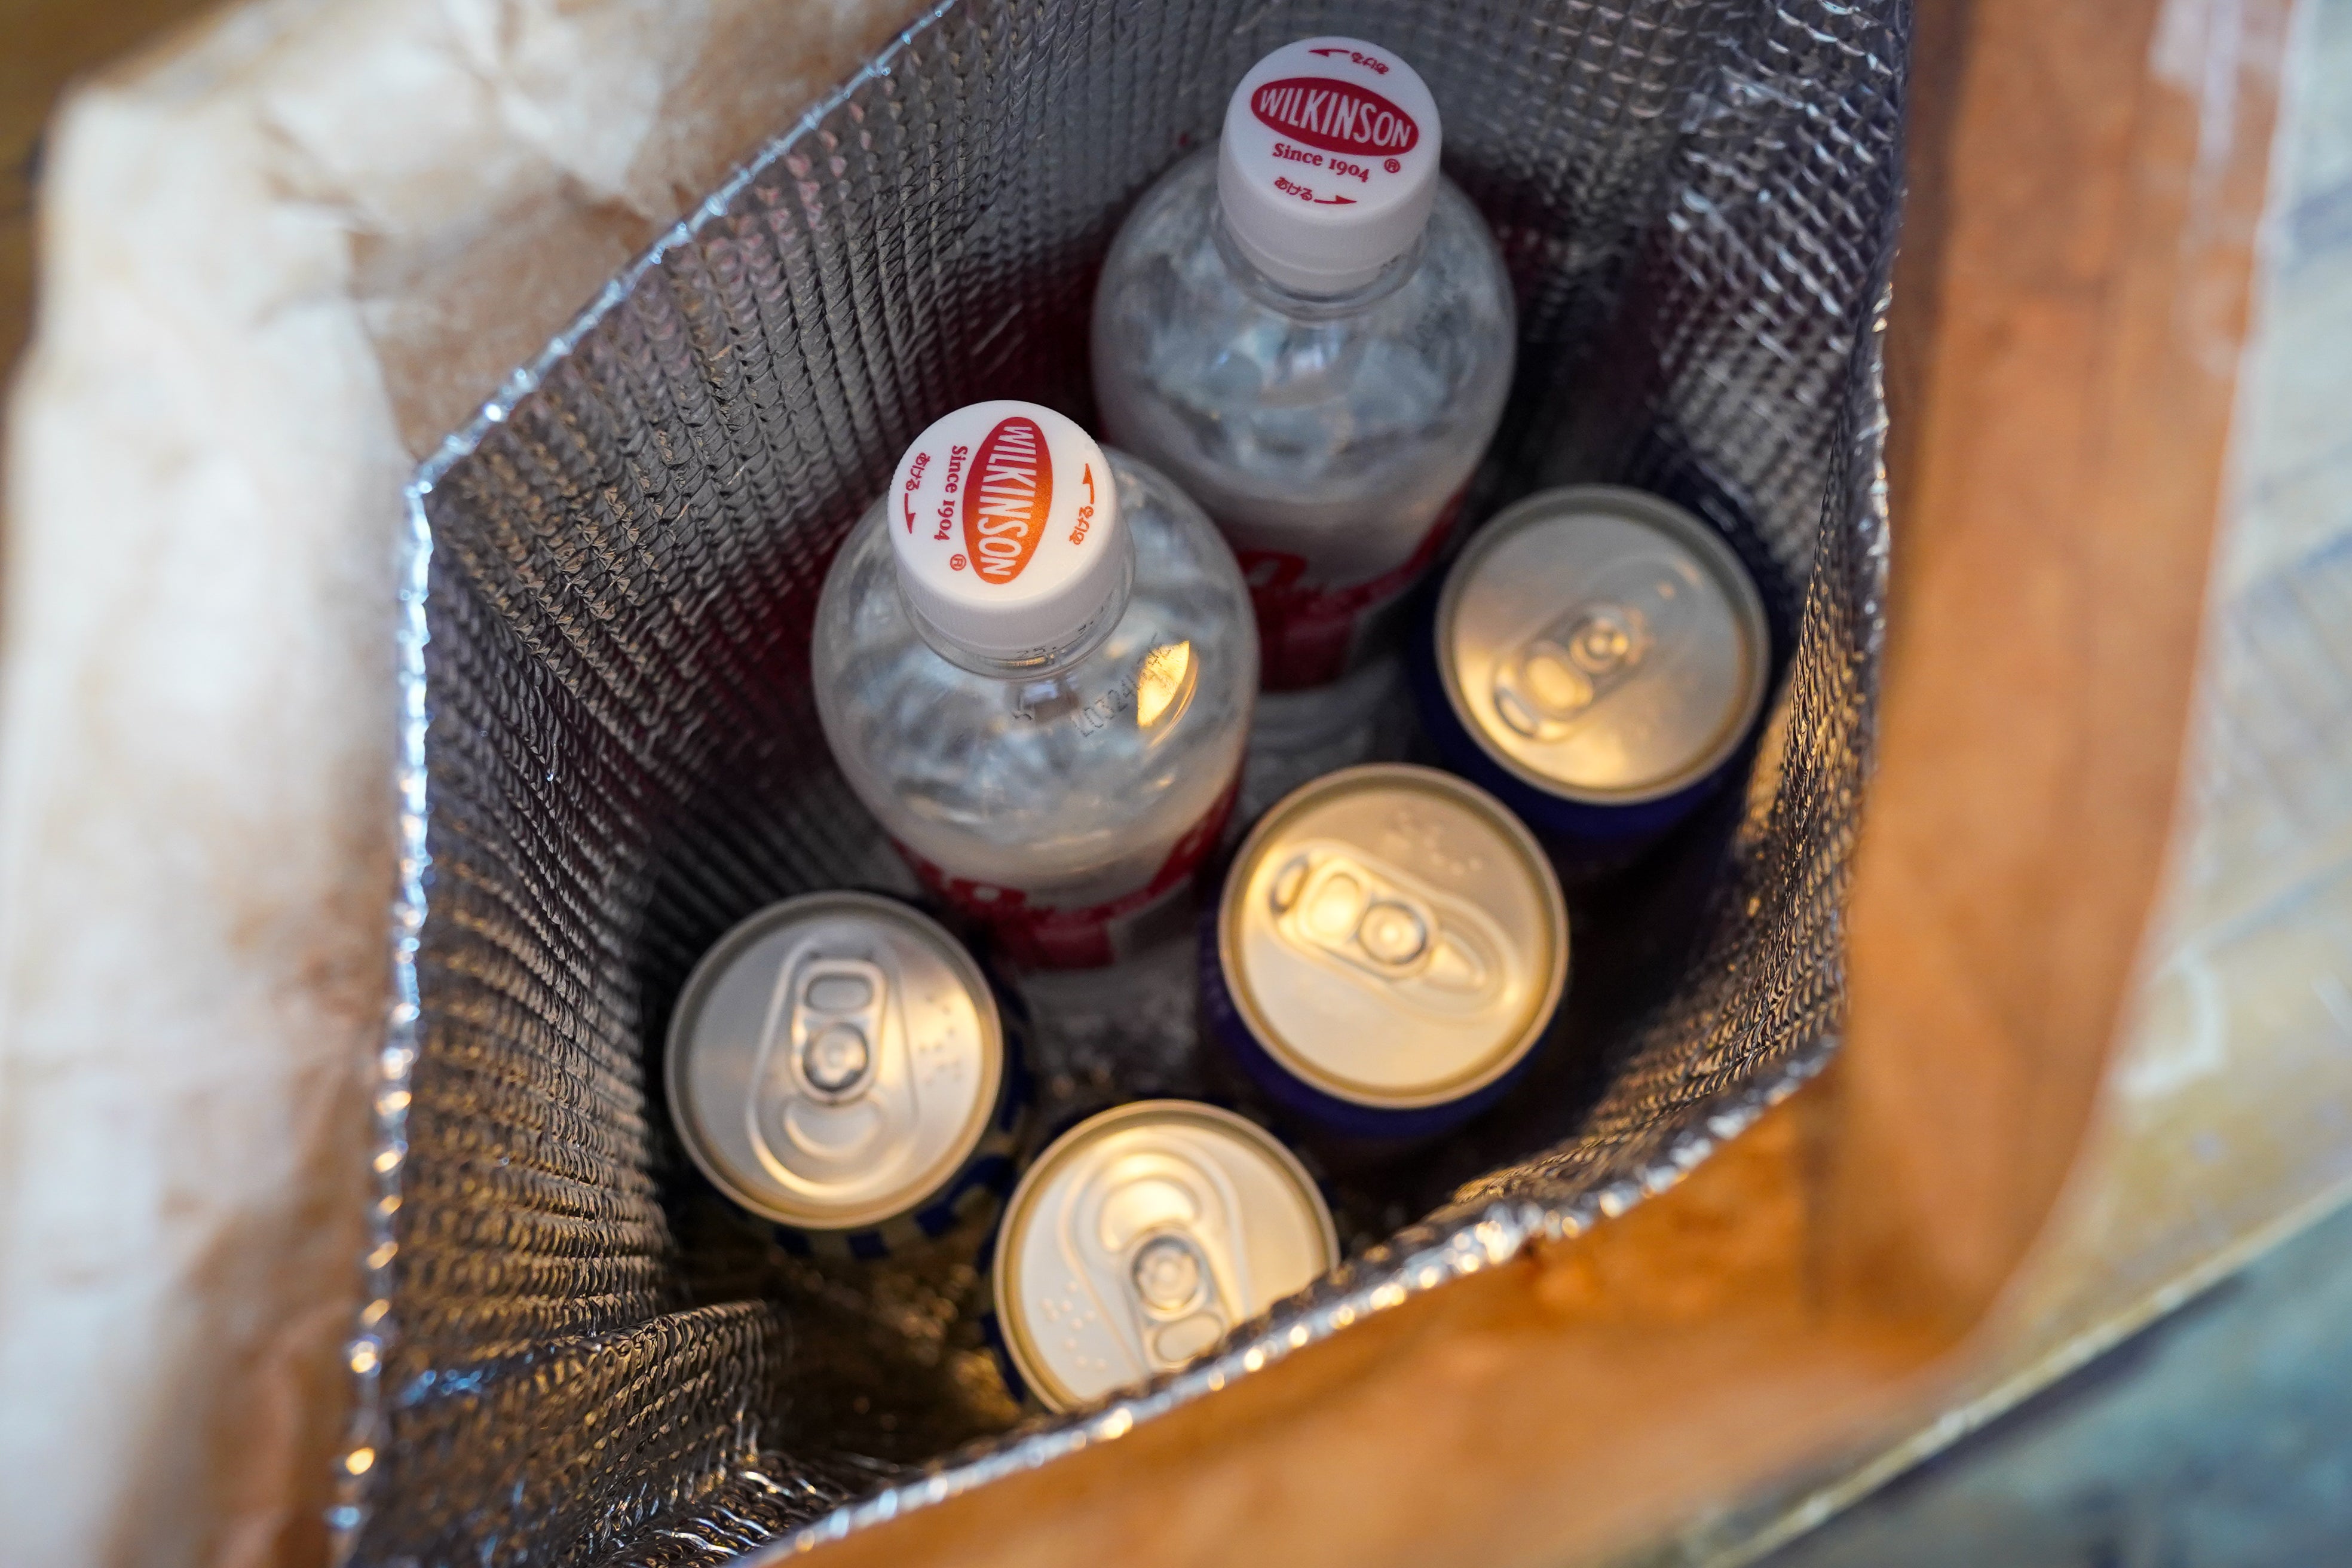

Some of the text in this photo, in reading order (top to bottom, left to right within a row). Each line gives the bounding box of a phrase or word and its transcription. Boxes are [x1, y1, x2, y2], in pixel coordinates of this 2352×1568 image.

[1350, 51, 1389, 75] あける
[1259, 87, 1411, 148] WILKINSON
[1273, 142, 1370, 183] Since 1904
[1274, 176, 1313, 201] あける
[905, 452, 931, 492] あける
[933, 445, 969, 541] Since 1904
[976, 425, 1037, 576] WILKINSON
[1068, 505, 1094, 546] あける
